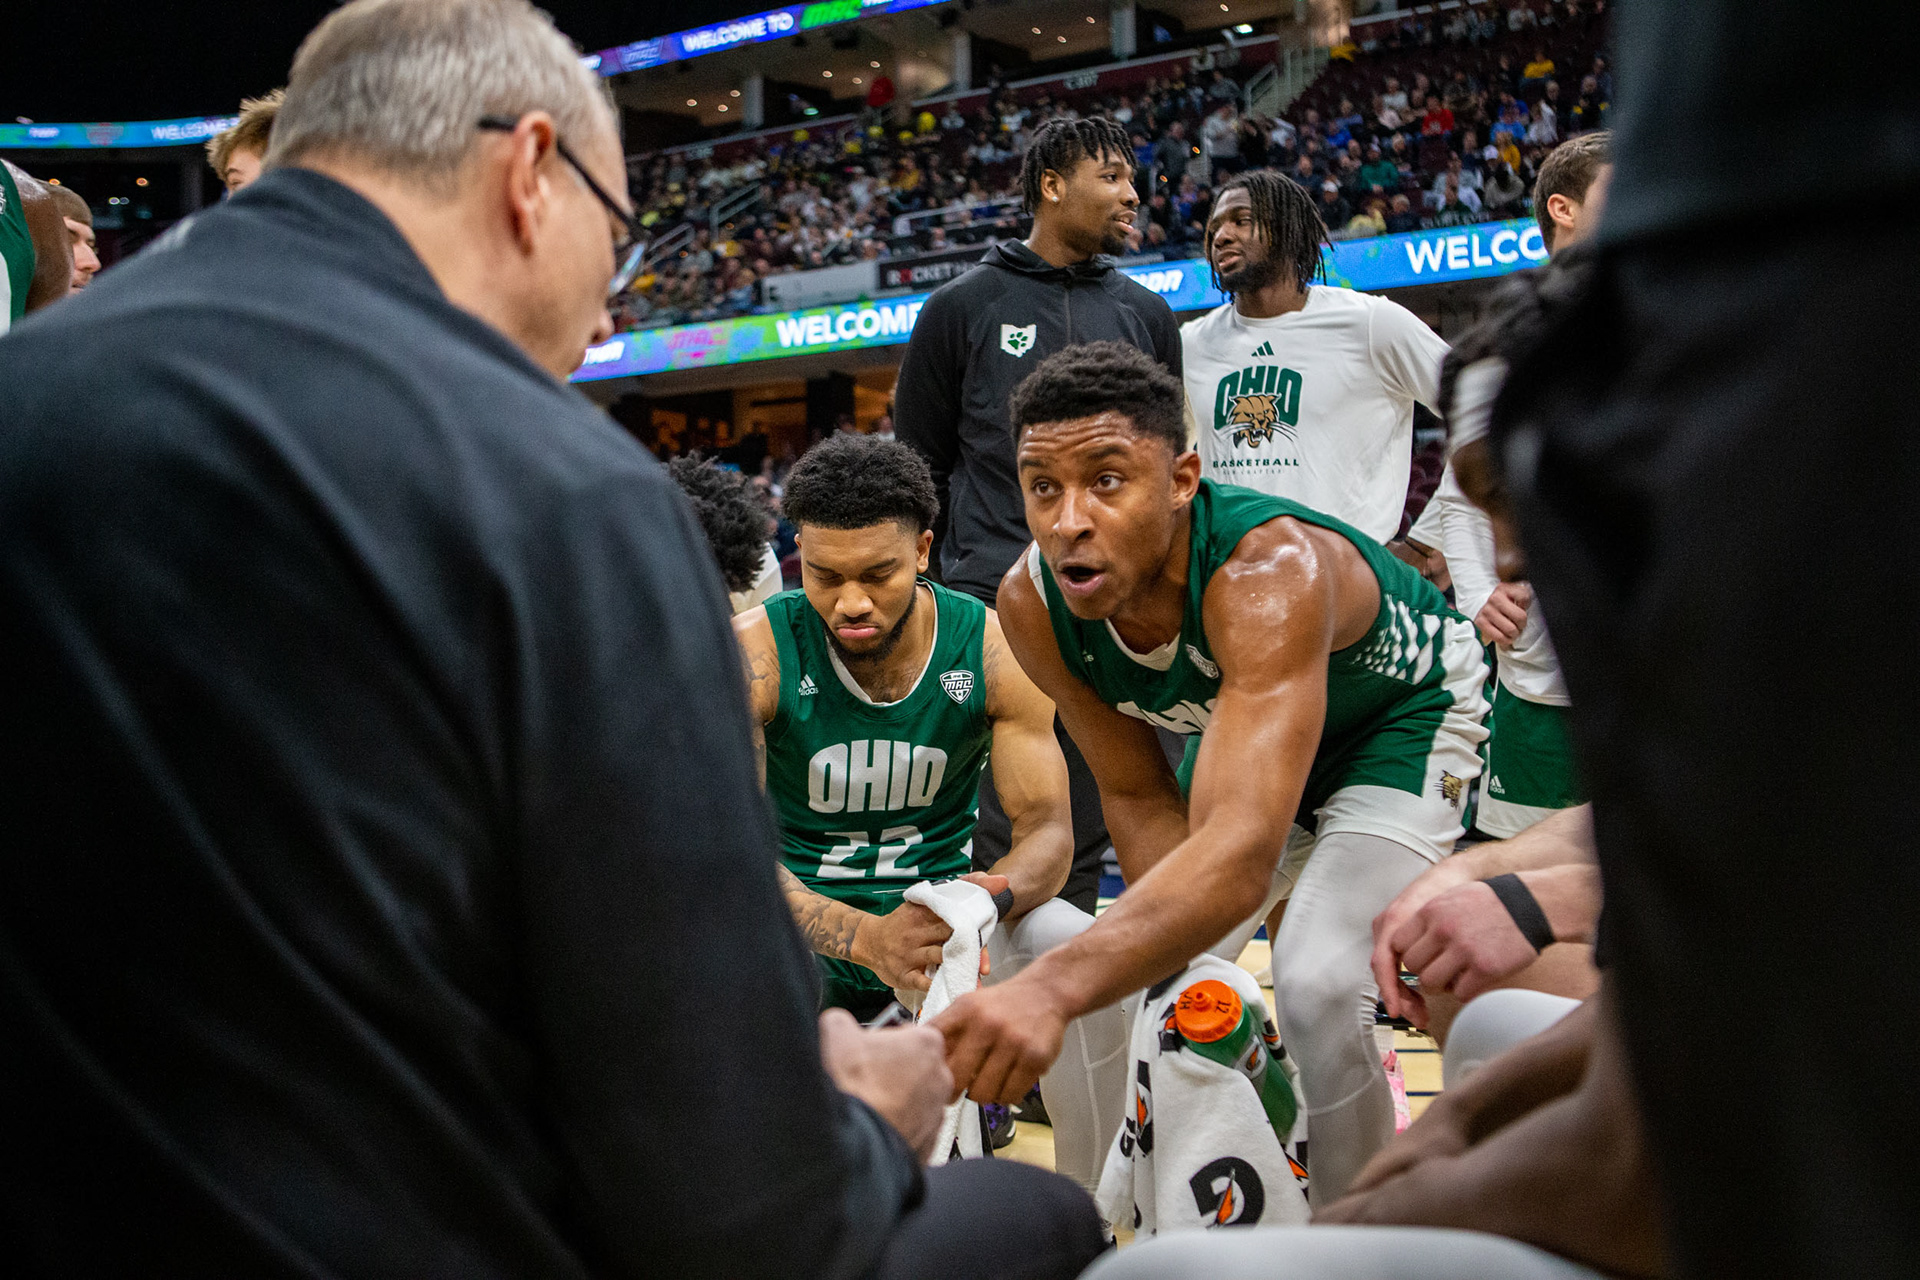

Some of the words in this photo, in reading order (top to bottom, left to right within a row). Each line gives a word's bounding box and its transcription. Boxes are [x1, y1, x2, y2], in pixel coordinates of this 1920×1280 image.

[682, 18, 766, 52] WELCOME
[766, 12, 794, 33] TO
[1214, 365, 1303, 431] OHIO
[1213, 458, 1299, 468] BASKETBALL
[944, 679, 974, 690] MAC
[808, 739, 948, 814] OHIO
[816, 824, 924, 878] 22
